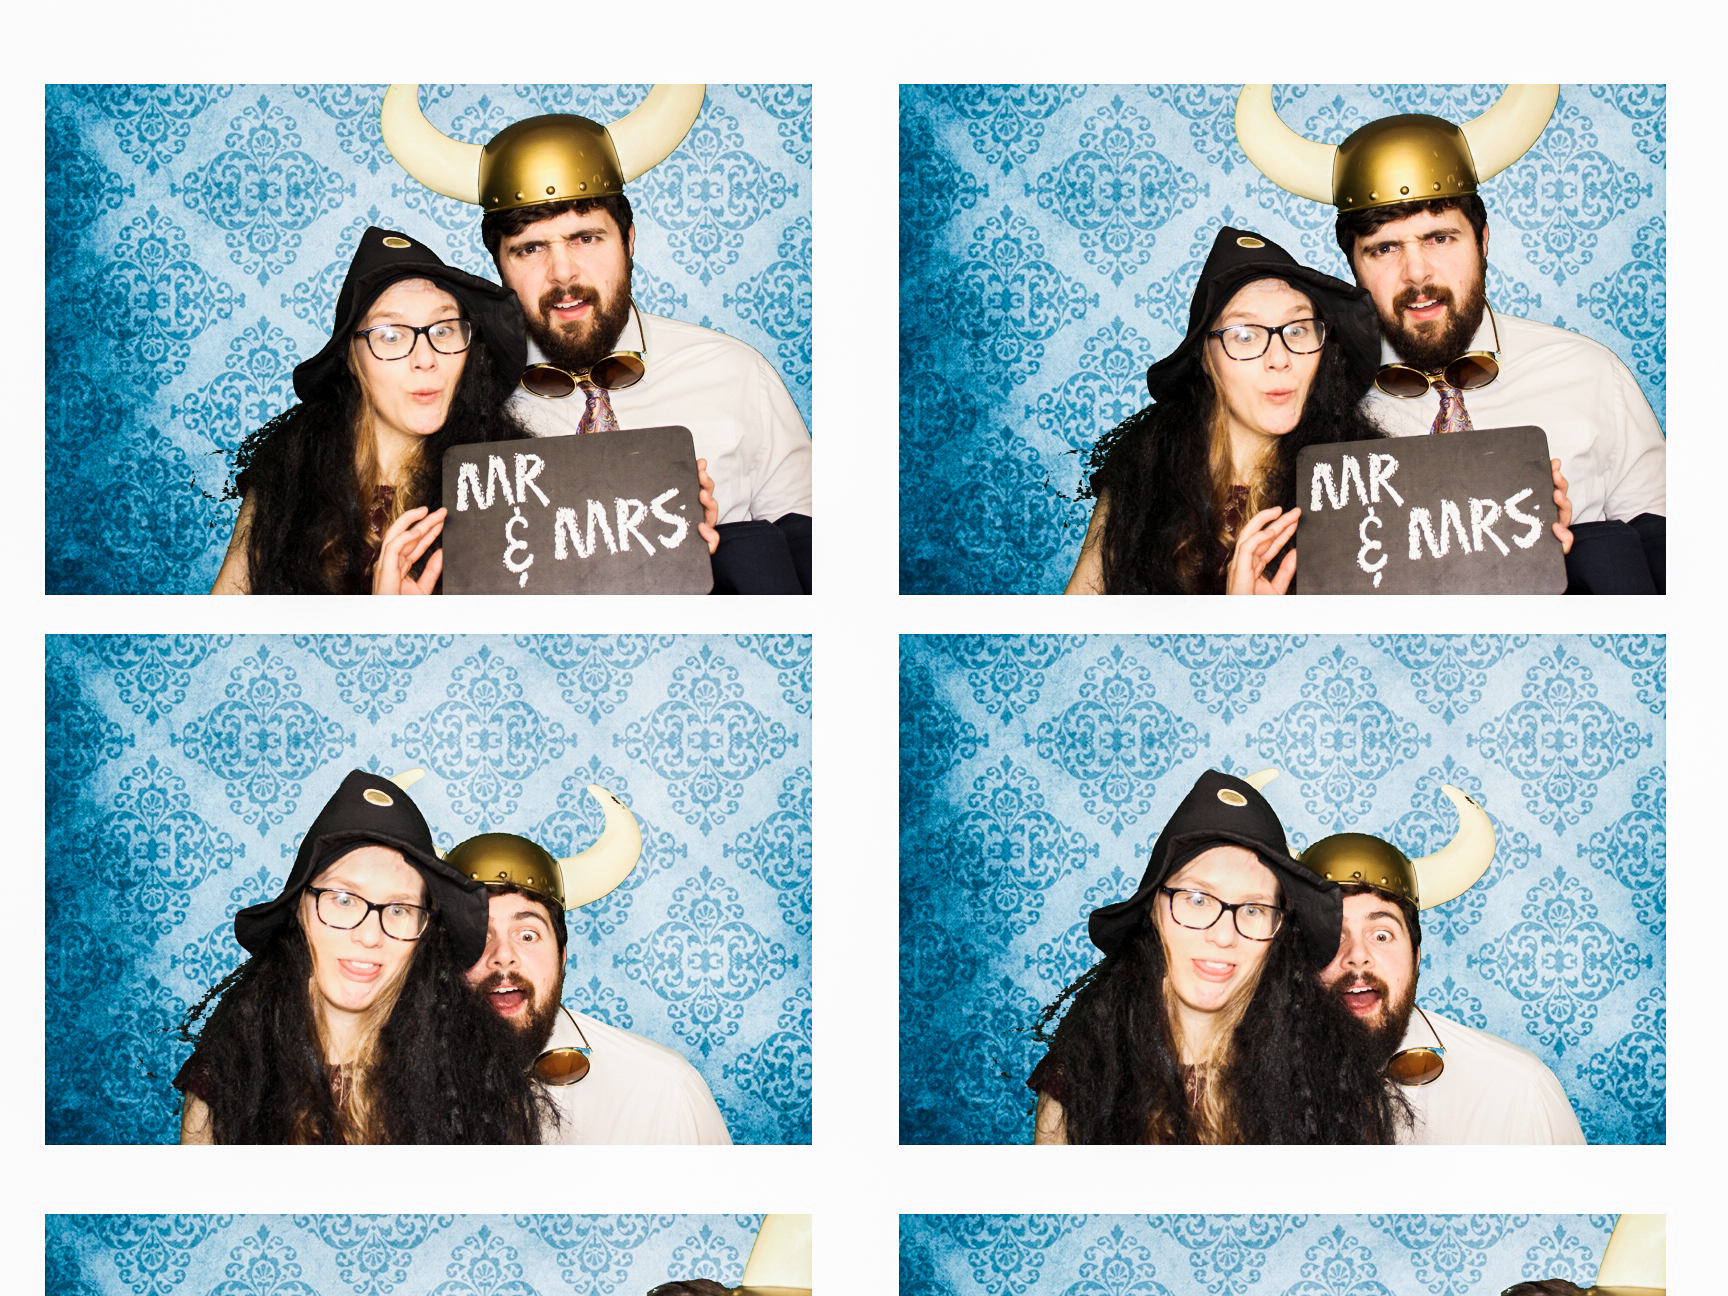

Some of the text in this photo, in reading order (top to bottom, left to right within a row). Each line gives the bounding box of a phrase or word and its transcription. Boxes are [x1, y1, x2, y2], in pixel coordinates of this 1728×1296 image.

[456, 452, 550, 512] MR
[1310, 452, 1404, 512] MR
[503, 488, 691, 588] & MRS
[1357, 488, 1545, 588] & MRS
